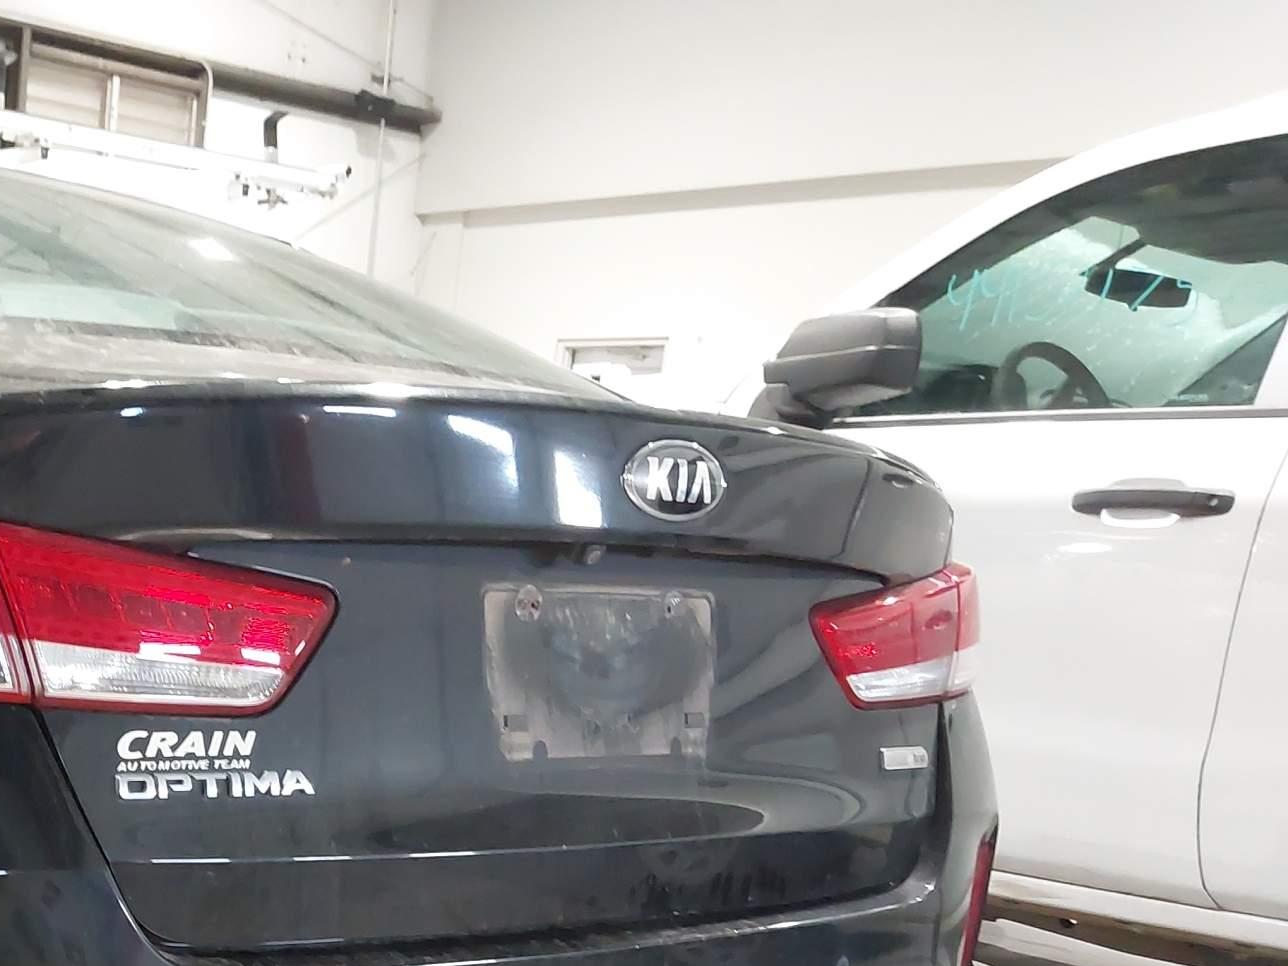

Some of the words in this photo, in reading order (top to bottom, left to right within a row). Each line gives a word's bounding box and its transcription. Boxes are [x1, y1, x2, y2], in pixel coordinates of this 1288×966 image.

[646, 456, 712, 504] KIA
[116, 730, 256, 760] CRAIN
[116, 759, 210, 772] AUTOMOTIVE
[214, 758, 251, 770] TEAM
[115, 769, 316, 800] OPTIMA
